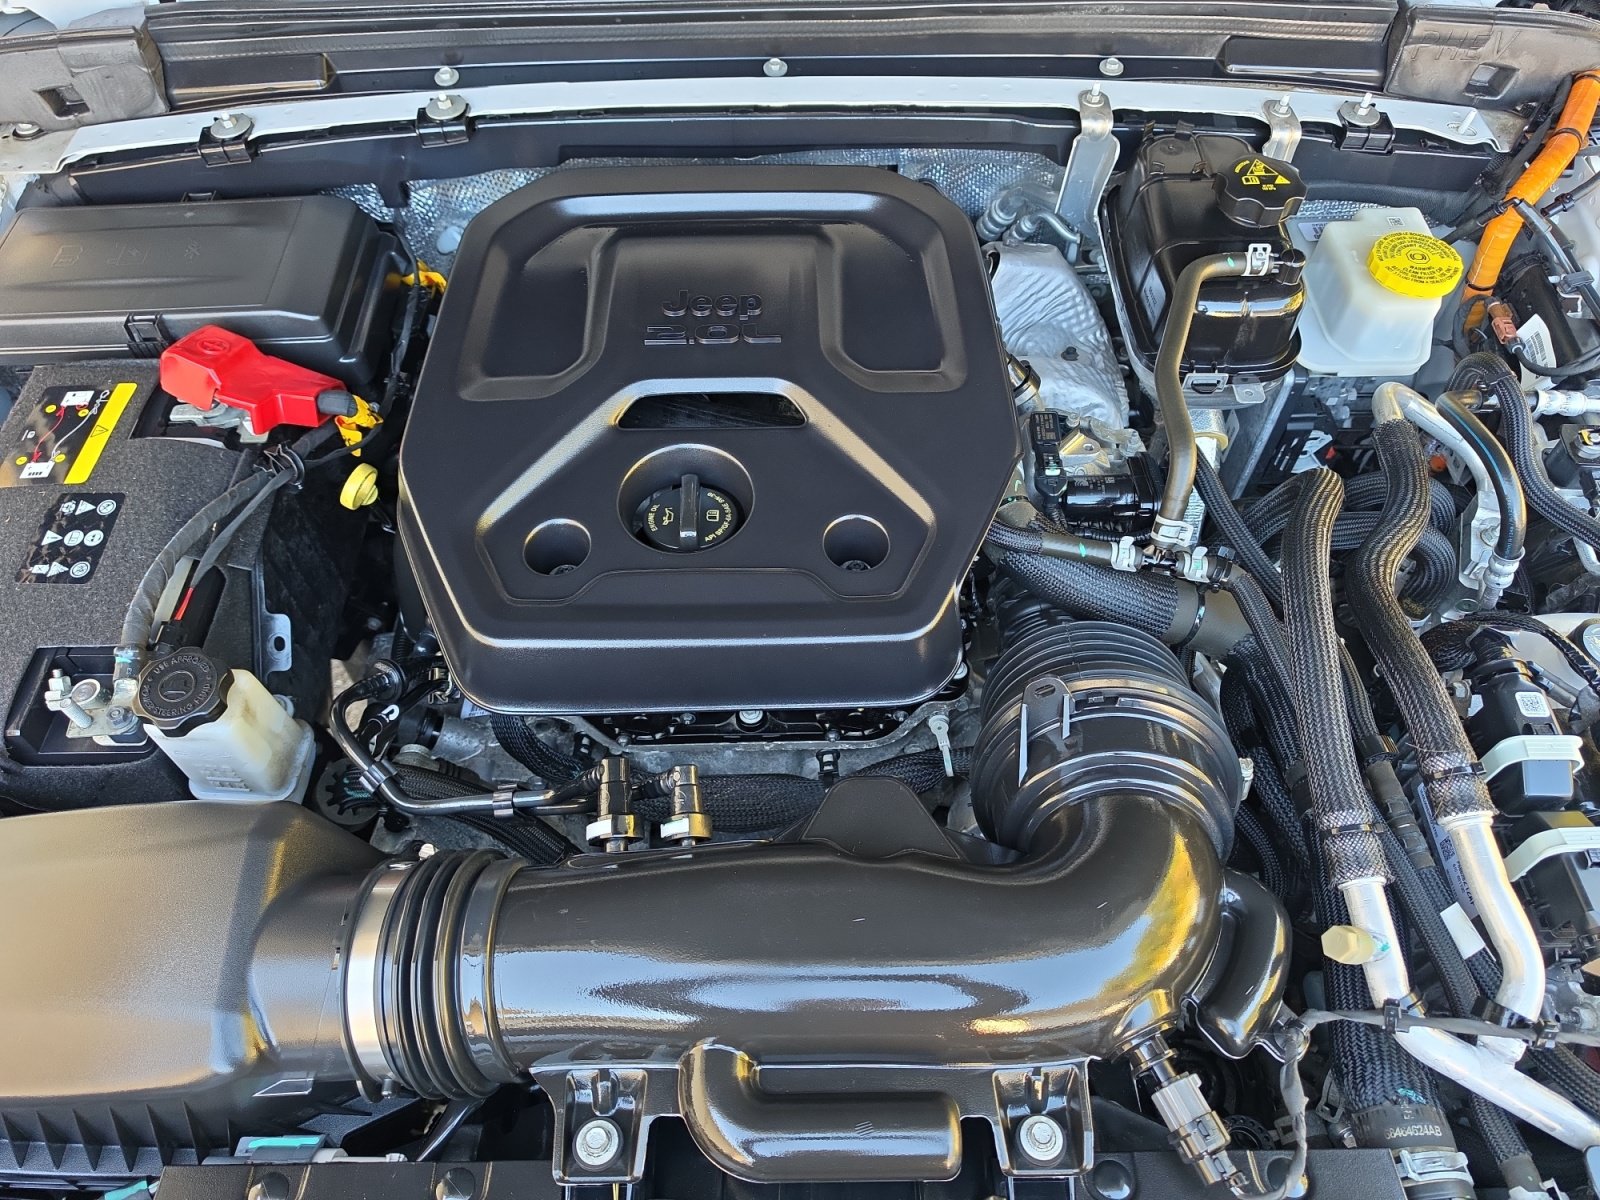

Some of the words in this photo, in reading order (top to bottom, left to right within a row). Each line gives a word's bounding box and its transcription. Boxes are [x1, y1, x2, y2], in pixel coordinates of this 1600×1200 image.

[662, 290, 762, 321] Jeep
[644, 323, 782, 346] 2.0L
[651, 504, 660, 512] OIL
[648, 513, 658, 532] ENGINE
[705, 534, 717, 542] API
[153, 661, 169, 674] USE
[171, 655, 210, 673] APPROVED
[153, 702, 193, 717] STEERING
[194, 683, 211, 705] FLUID
